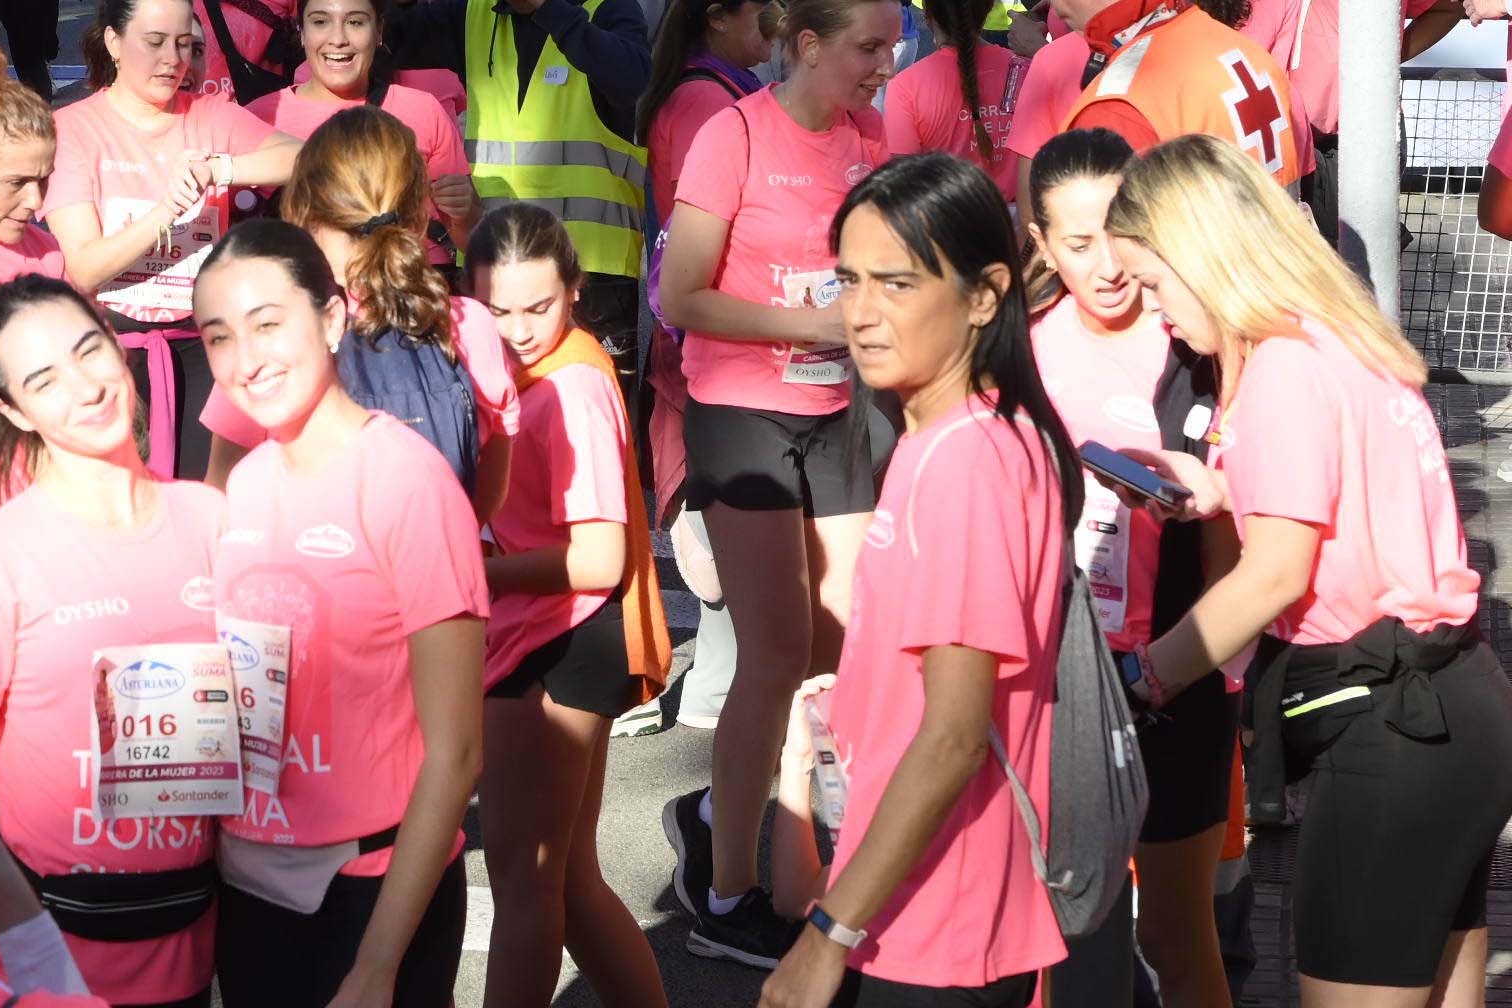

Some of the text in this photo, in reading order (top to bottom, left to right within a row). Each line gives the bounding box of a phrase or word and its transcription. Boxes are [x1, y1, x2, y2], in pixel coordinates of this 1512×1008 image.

[768, 174, 813, 187] OYSHO
[796, 366, 831, 377] OYSHO
[53, 595, 129, 626] OYSHO
[120, 676, 178, 691] ASTURIANA
[122, 713, 178, 738] 016
[125, 745, 171, 761] 16742
[129, 765, 225, 778] DE LA MUJER 2023
[171, 788, 229, 802] Santander
